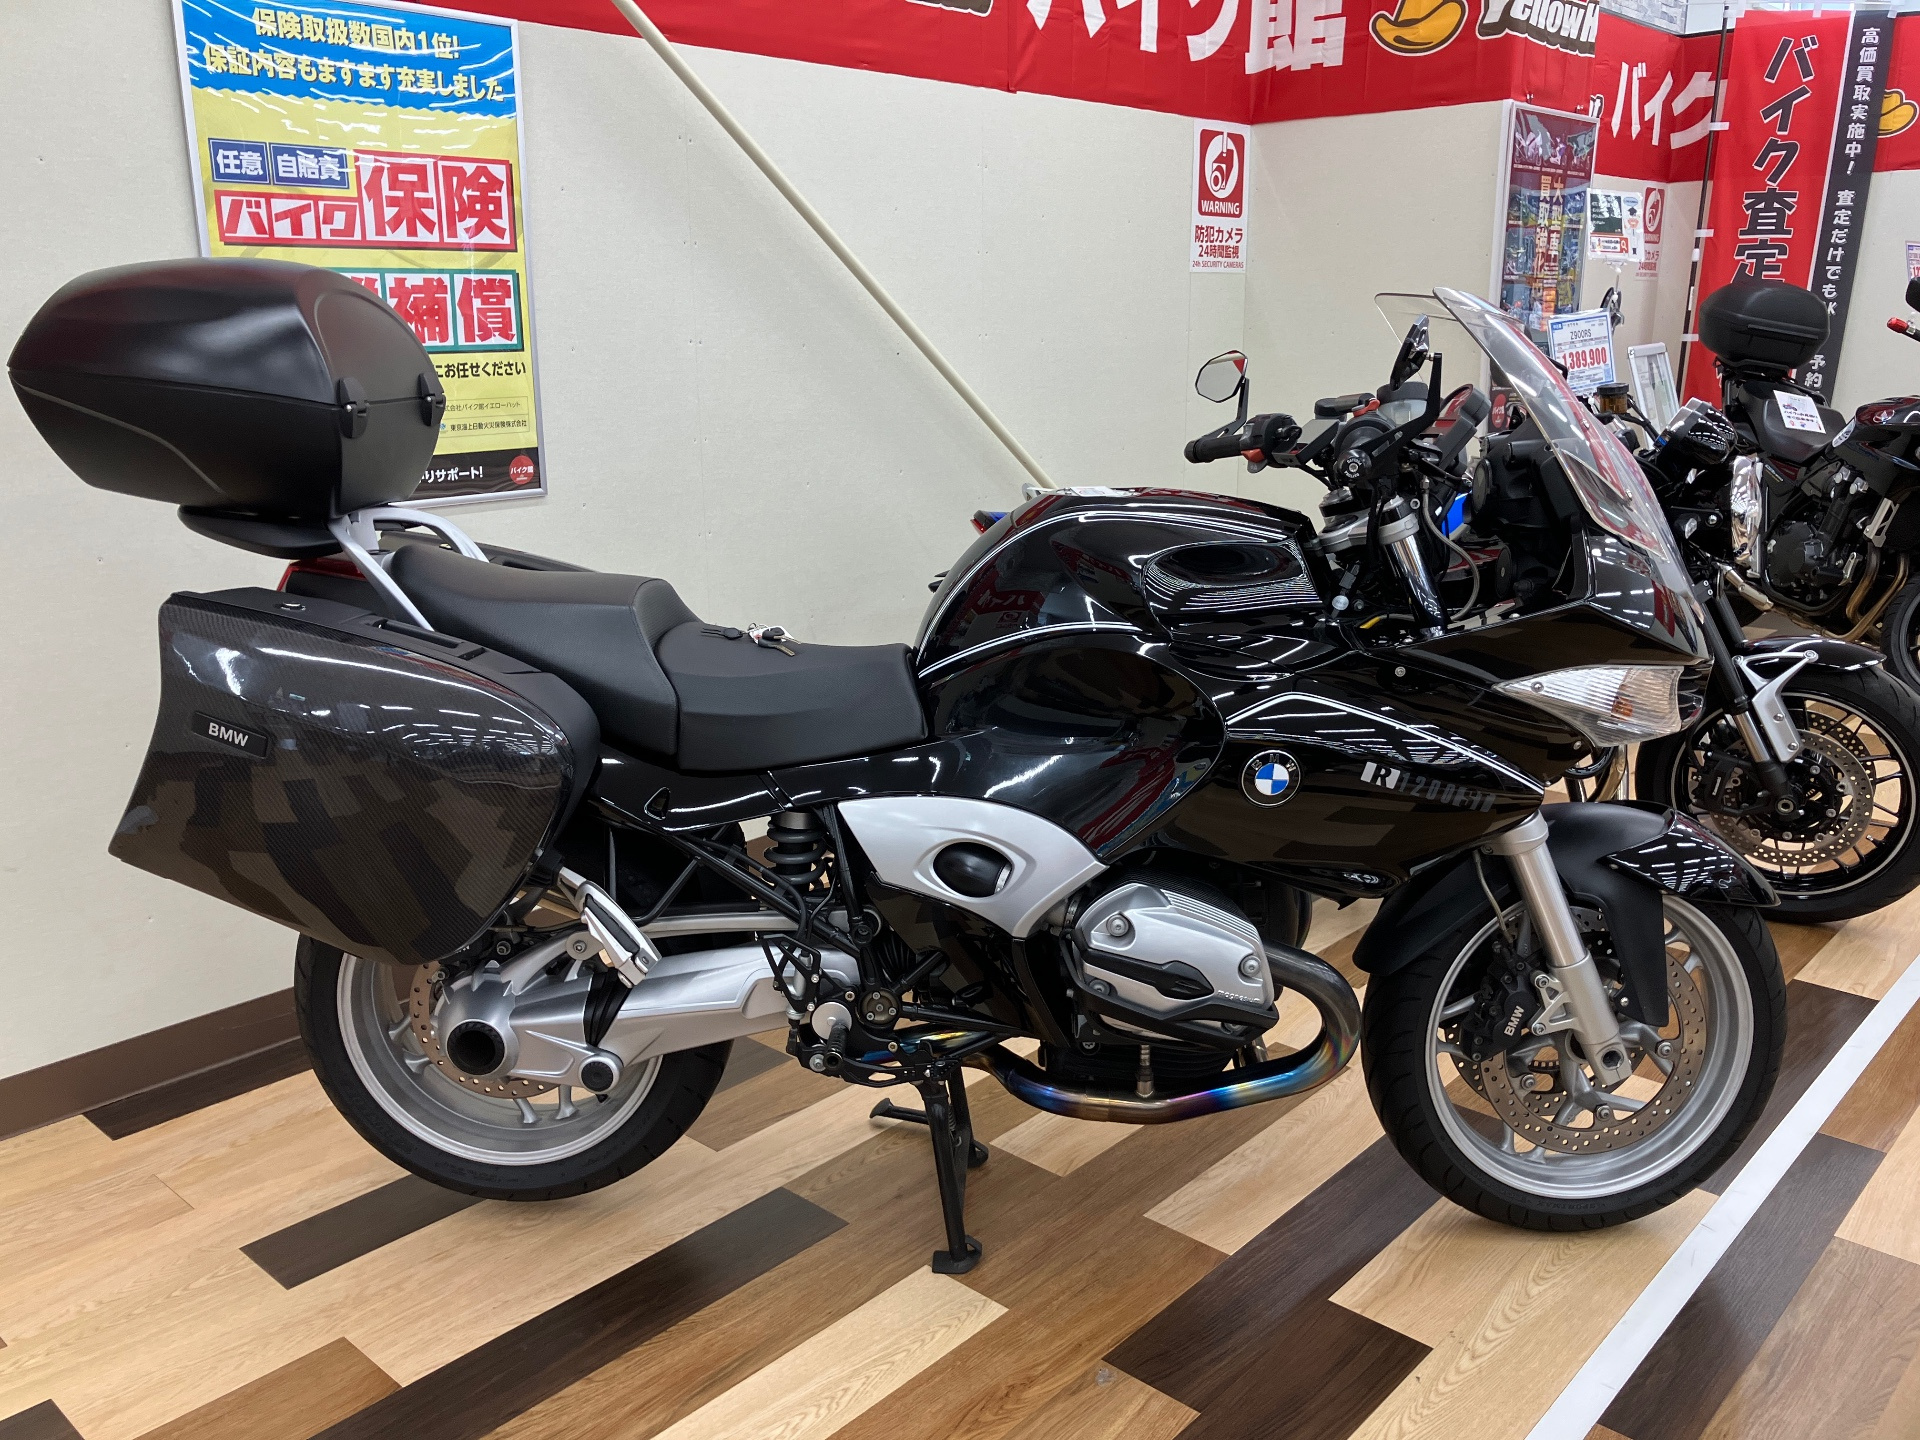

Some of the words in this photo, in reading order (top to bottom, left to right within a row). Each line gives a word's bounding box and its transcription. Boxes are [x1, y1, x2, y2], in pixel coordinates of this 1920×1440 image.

[252, 7, 461, 60] 保険取扱数国内1位!
[202, 44, 505, 102] 保証内容もますます充実しました
[216, 149, 264, 176] 任意
[277, 152, 342, 182] 自賠責
[1201, 200, 1240, 215] WARNING
[1194, 225, 1243, 244] 防犯カメラ
[1198, 245, 1239, 259] 24時間監視
[1201, 261, 1223, 269] SECURITY
[1822, 189, 1856, 316] 査定だけでもK
[350, 275, 516, 343] 補償
[1570, 329, 1592, 340] Z900RS
[208, 722, 249, 747] BMW
[1250, 753, 1297, 772] BMW
[1504, 1005, 1525, 1037] BMW
